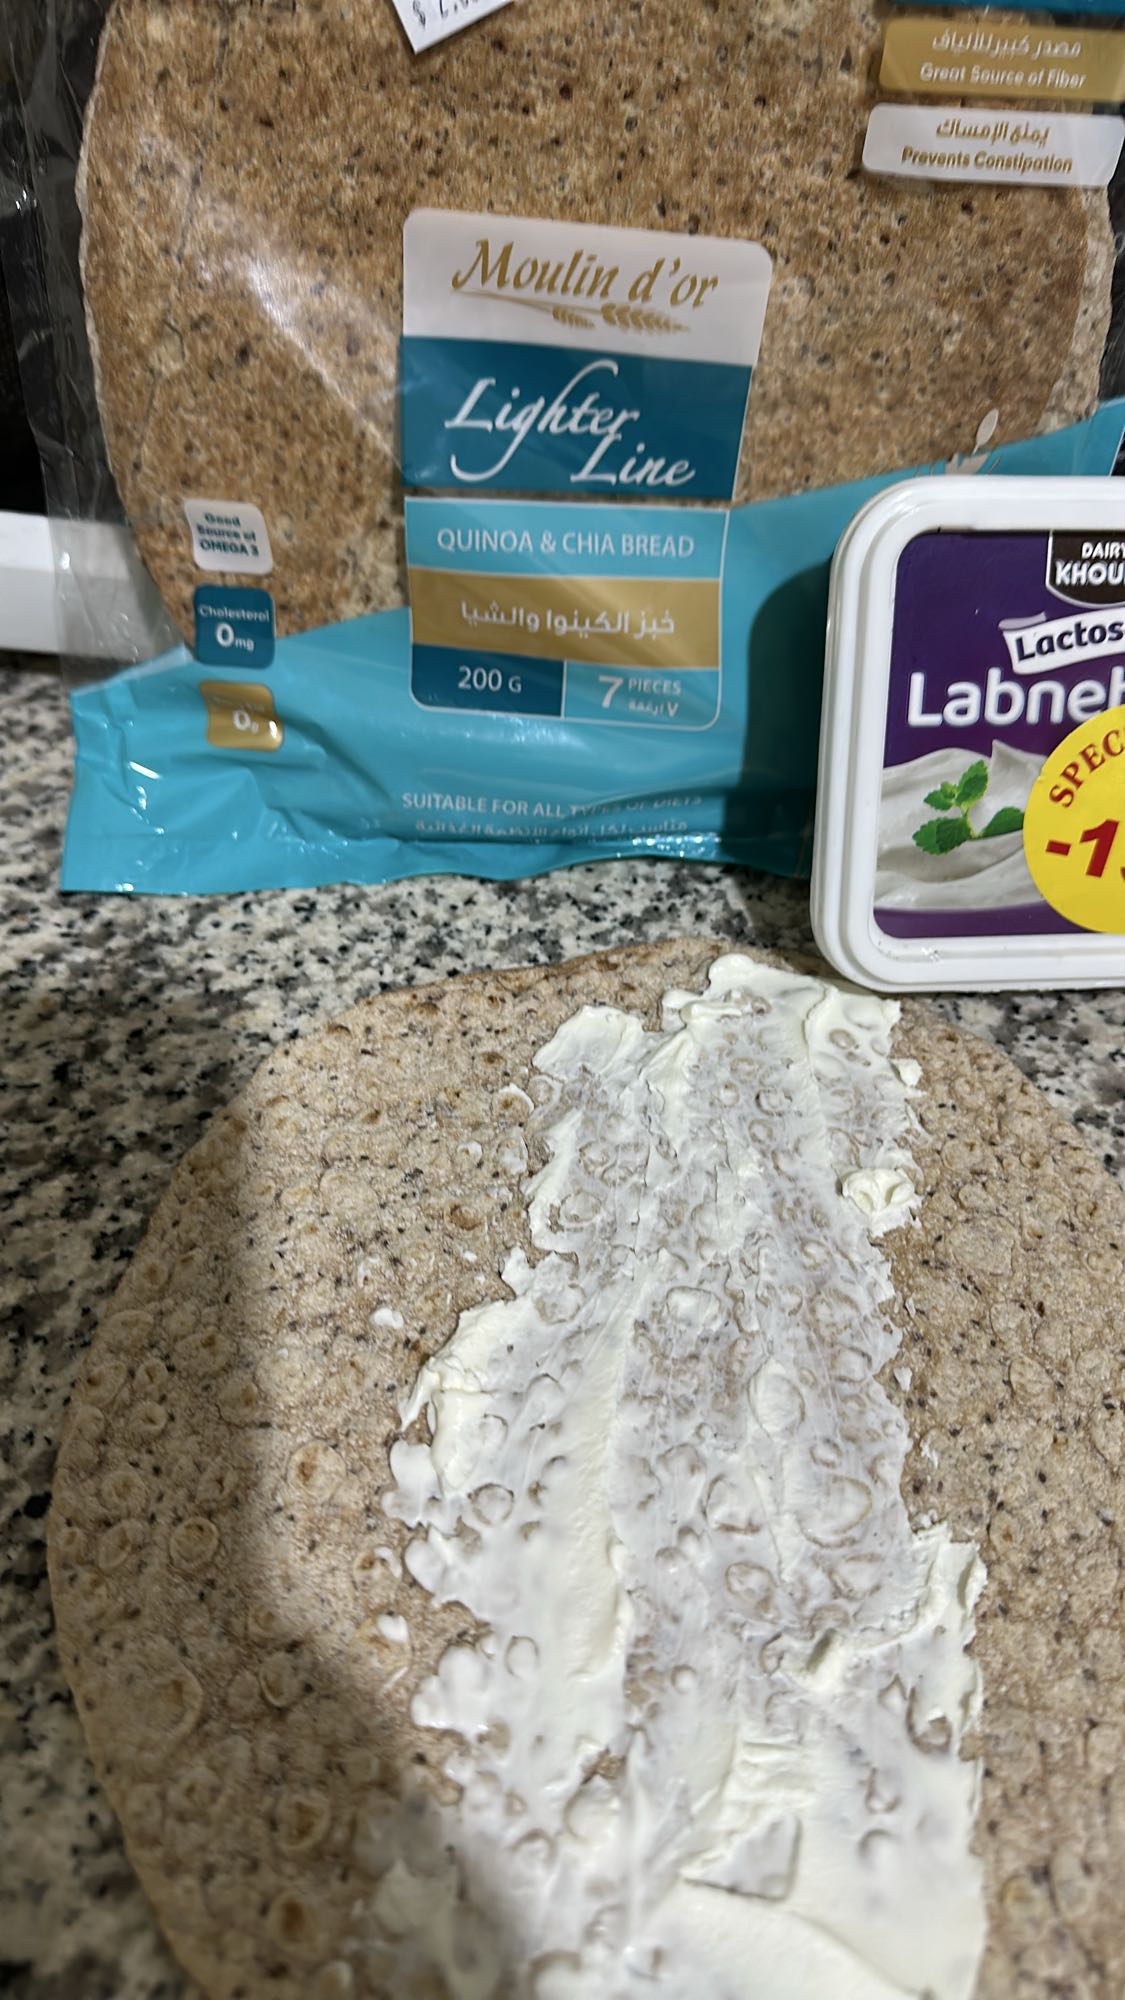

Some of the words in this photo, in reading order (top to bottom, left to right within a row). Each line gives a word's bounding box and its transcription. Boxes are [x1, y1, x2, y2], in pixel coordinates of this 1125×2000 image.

[991, 34, 1030, 61] كبير
[1031, 39, 1082, 60] مصدر
[920, 62, 966, 82] Great
[971, 65, 1024, 87] Source
[1027, 71, 1044, 87] of
[1046, 71, 1087, 89] Fiber
[901, 145, 970, 168] Prevents
[974, 151, 1073, 175] Constipation
[451, 238, 619, 299] Moulin
[628, 257, 719, 308] d'or
[444, 359, 640, 482] Lighter
[570, 433, 695, 486] Line
[197, 523, 241, 539] Source
[203, 512, 241, 528] Good
[200, 539, 249, 556] OMEGA
[250, 544, 259, 556] 3
[437, 528, 533, 553] QUINOA
[540, 532, 556, 553] &
[562, 532, 615, 556] CHIA
[621, 534, 694, 558] BREAD
[1056, 561, 1125, 586] KHOU
[198, 605, 269, 622] Cholesterol
[461, 599, 540, 632] والشيا
[546, 608, 629, 638] الكينوا
[633, 609, 675, 640] خبز
[1015, 620, 1125, 662] Lactos
[458, 666, 503, 692] 200
[508, 676, 522, 693] G
[598, 675, 624, 709] 7
[628, 677, 682, 696] PIECES
[1049, 729, 1125, 808] SPEC
[402, 792, 487, 812] SUITABLE
[491, 798, 529, 817] FOR
[532, 801, 565, 819] ALL
[1045, 819, 1125, 881] -1
